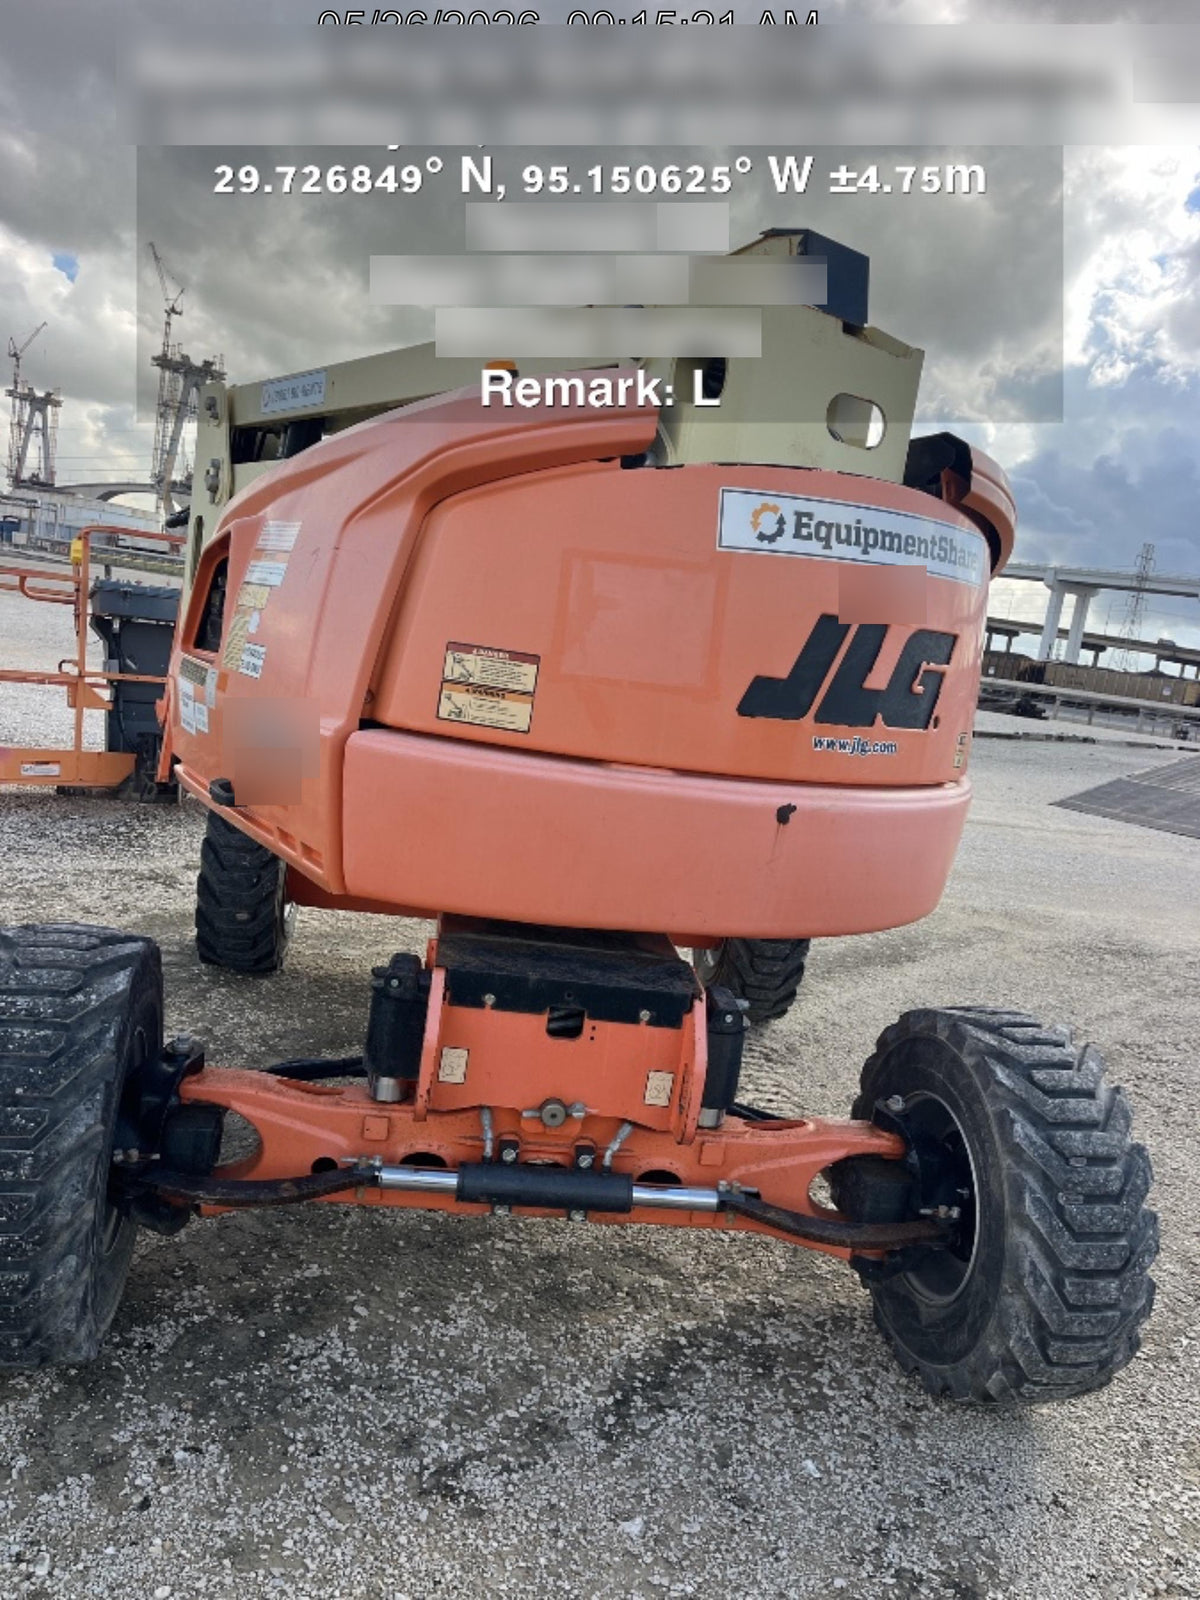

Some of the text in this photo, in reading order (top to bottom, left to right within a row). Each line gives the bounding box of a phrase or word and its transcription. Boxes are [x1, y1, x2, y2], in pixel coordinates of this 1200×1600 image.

[792, 510, 978, 573] EquipmentShare
[736, 613, 957, 731] JLG
[812, 736, 897, 755] www.jlg.com
